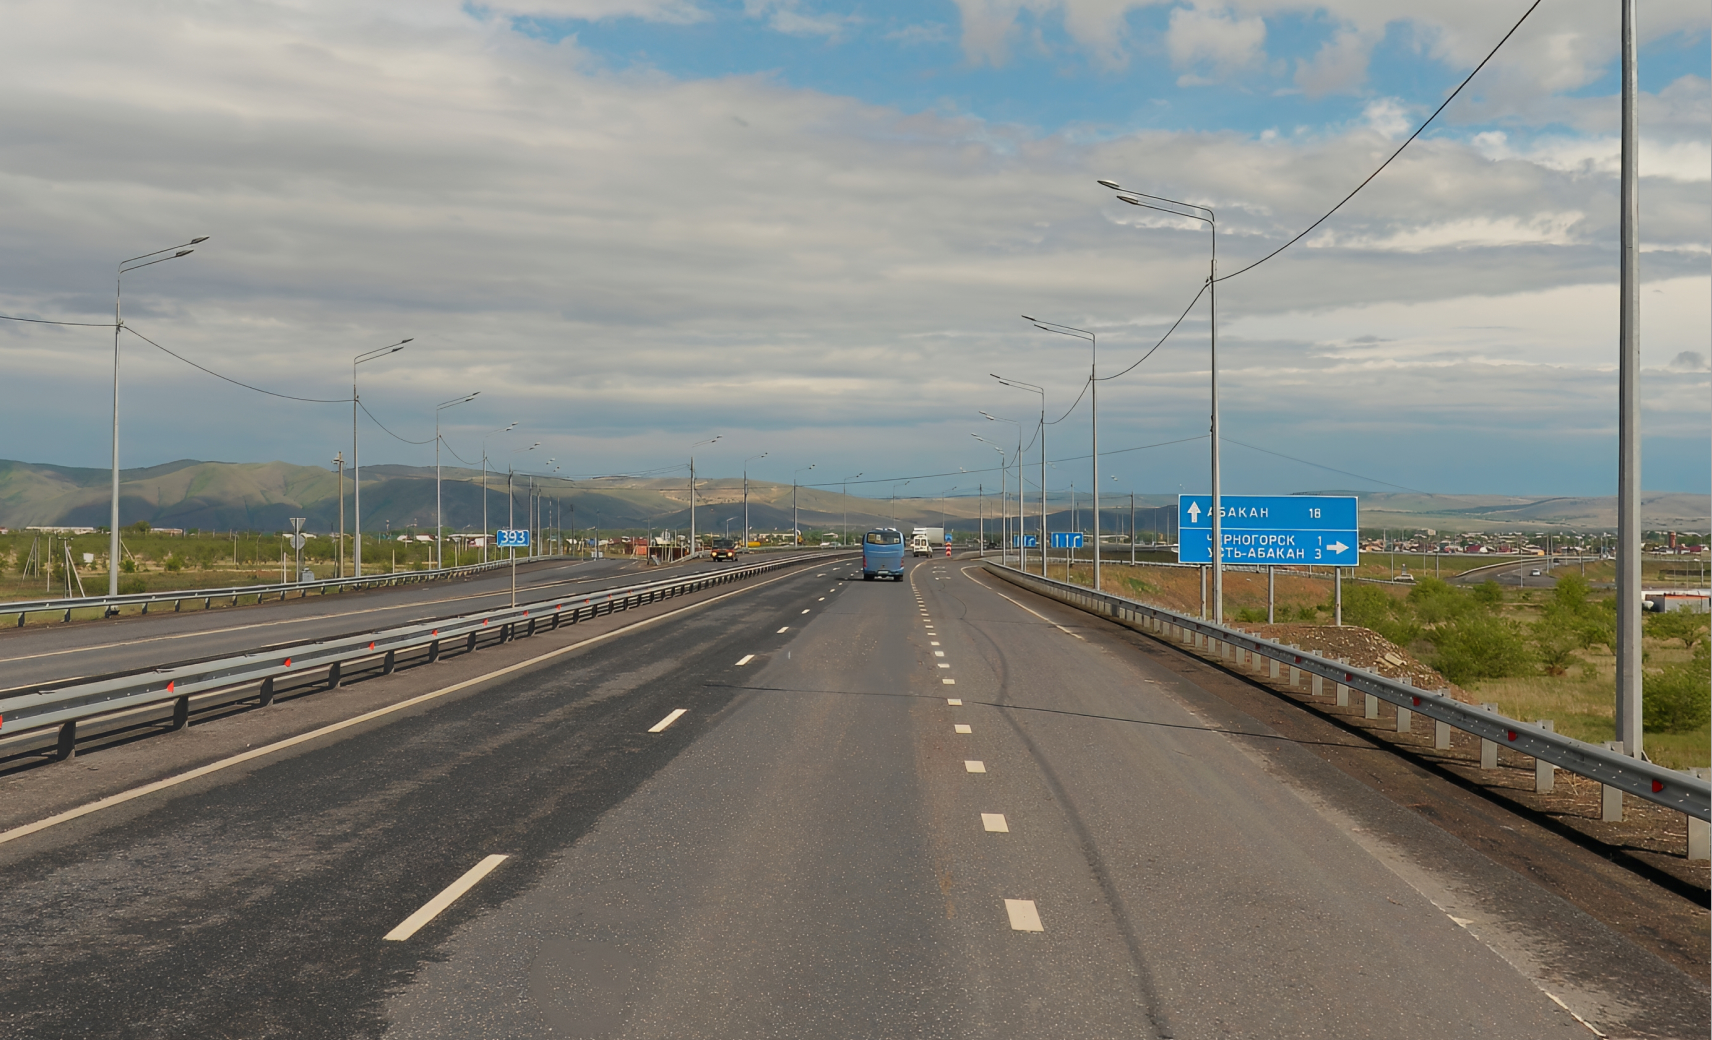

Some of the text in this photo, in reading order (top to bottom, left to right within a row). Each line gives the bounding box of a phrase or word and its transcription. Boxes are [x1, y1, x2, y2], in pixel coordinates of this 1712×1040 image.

[1207, 507, 1321, 519] АБАКАН 18
[501, 530, 525, 543] 393
[1206, 534, 1322, 546] ЧРНОГОРСК 1
[1314, 548, 1322, 560] 3
